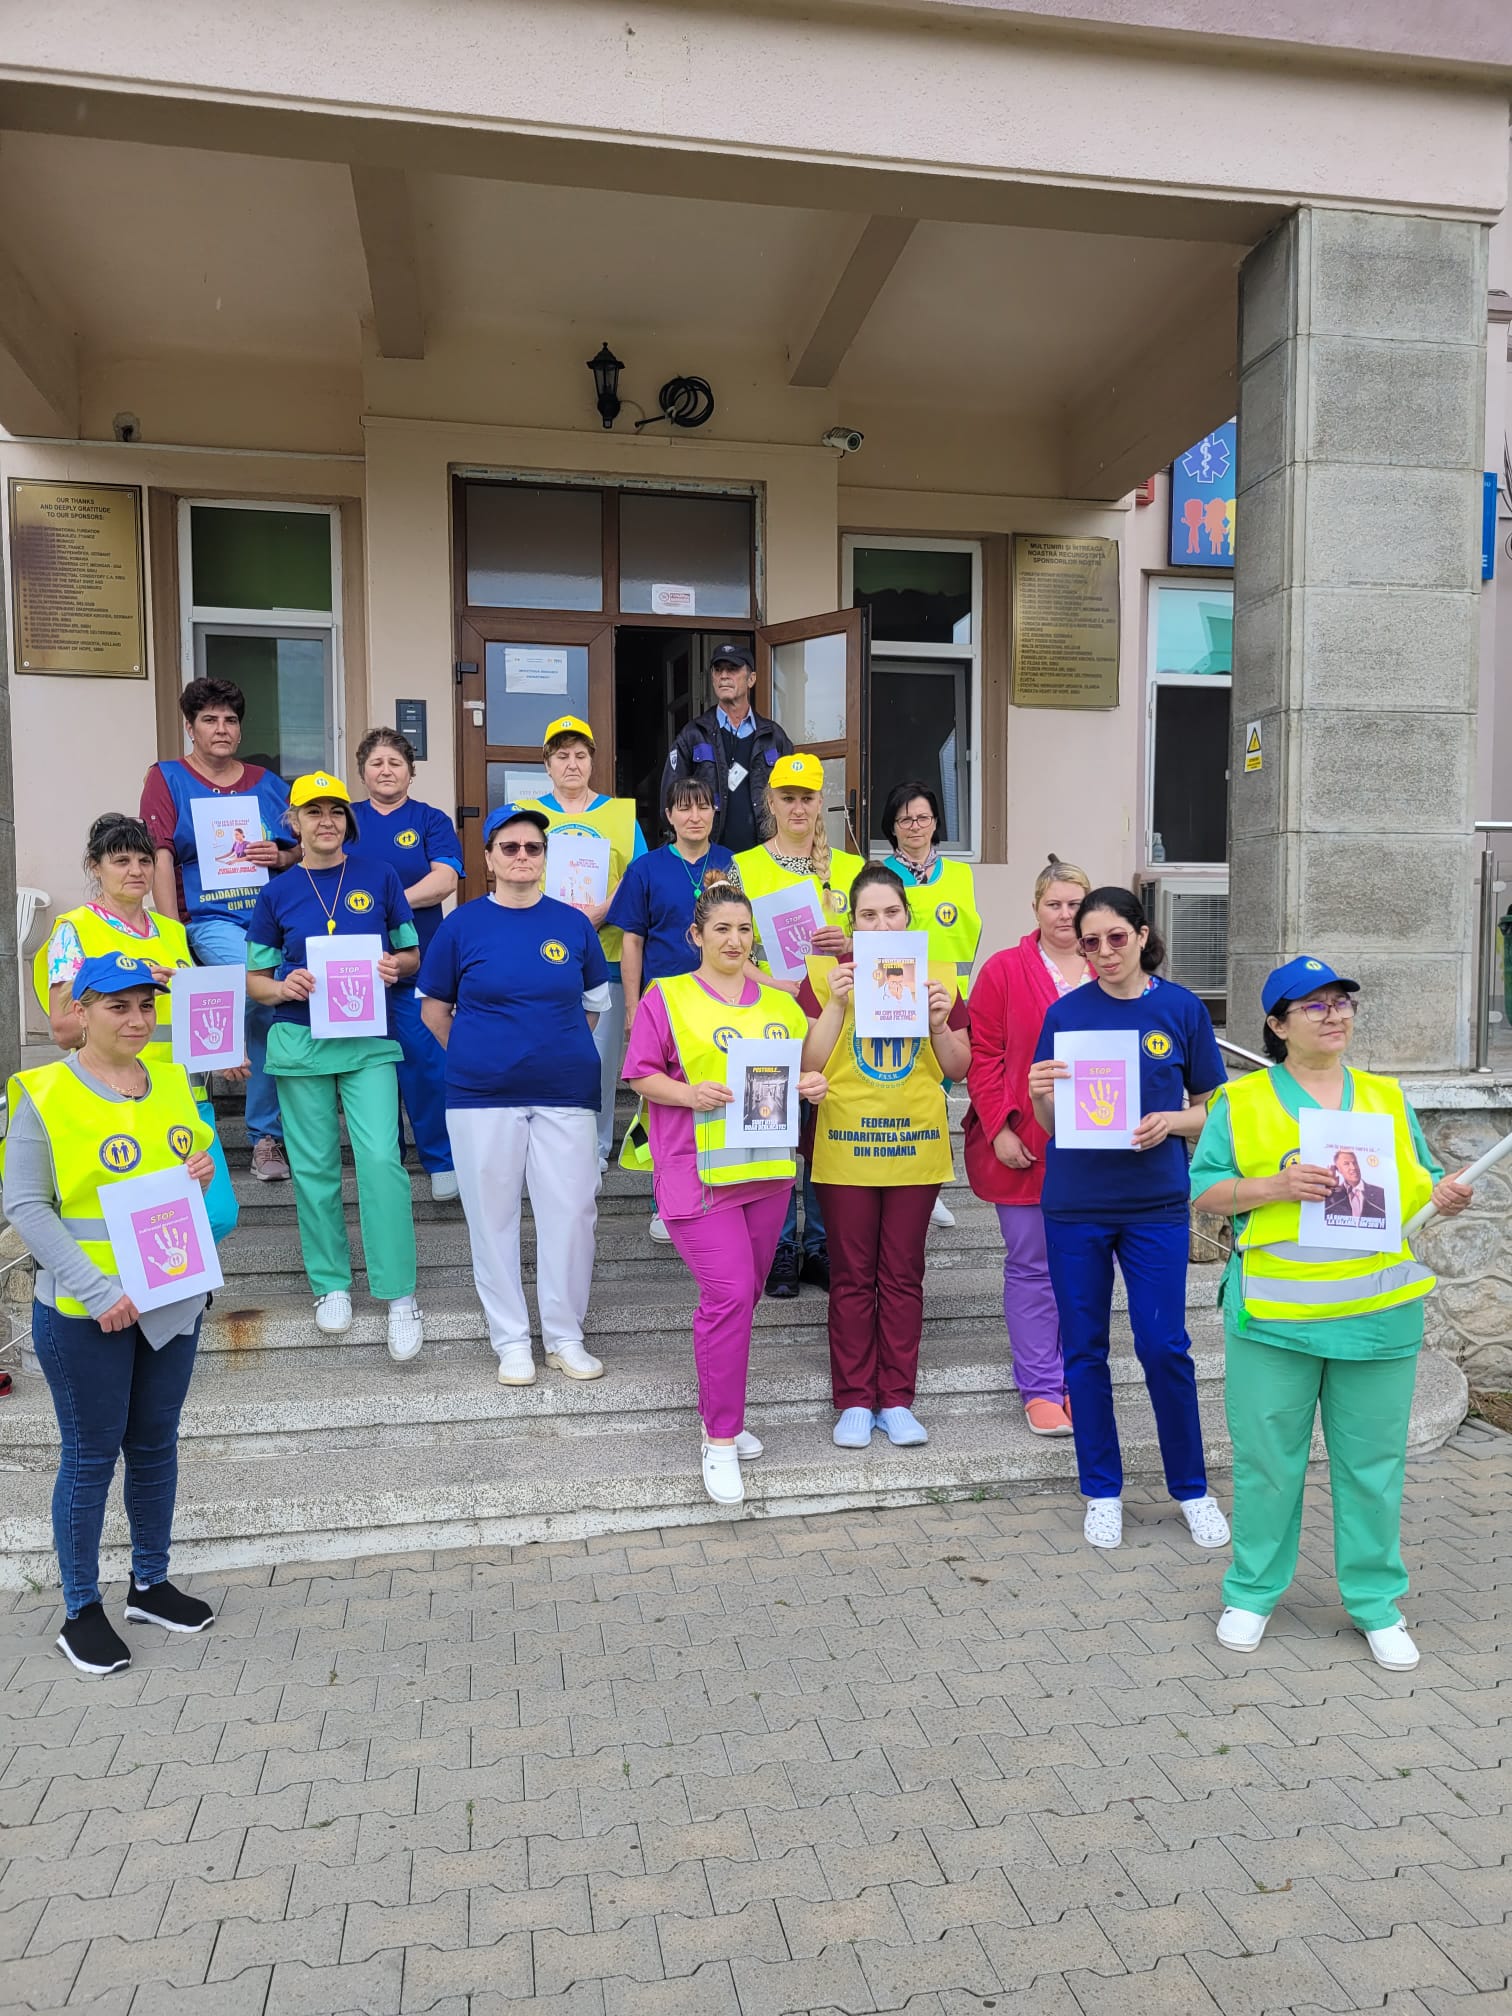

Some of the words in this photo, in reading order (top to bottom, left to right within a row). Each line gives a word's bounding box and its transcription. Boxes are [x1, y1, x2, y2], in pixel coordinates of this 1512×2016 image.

[77, 505, 111, 513] GRATITUDE
[227, 901, 243, 911] DIN
[785, 914, 802, 925] STOP
[339, 966, 360, 974] STOP
[202, 998, 222, 1006] STOP
[1089, 1067, 1111, 1075] STOP
[861, 1117, 911, 1131] FEDERAȚIA
[828, 1129, 898, 1143] SOLIDARITATEA
[899, 1127, 941, 1141] SANITARĂ
[853, 1146, 871, 1157] DIN
[873, 1145, 917, 1158] ROMÂNIA
[150, 1210, 175, 1225] STOP
